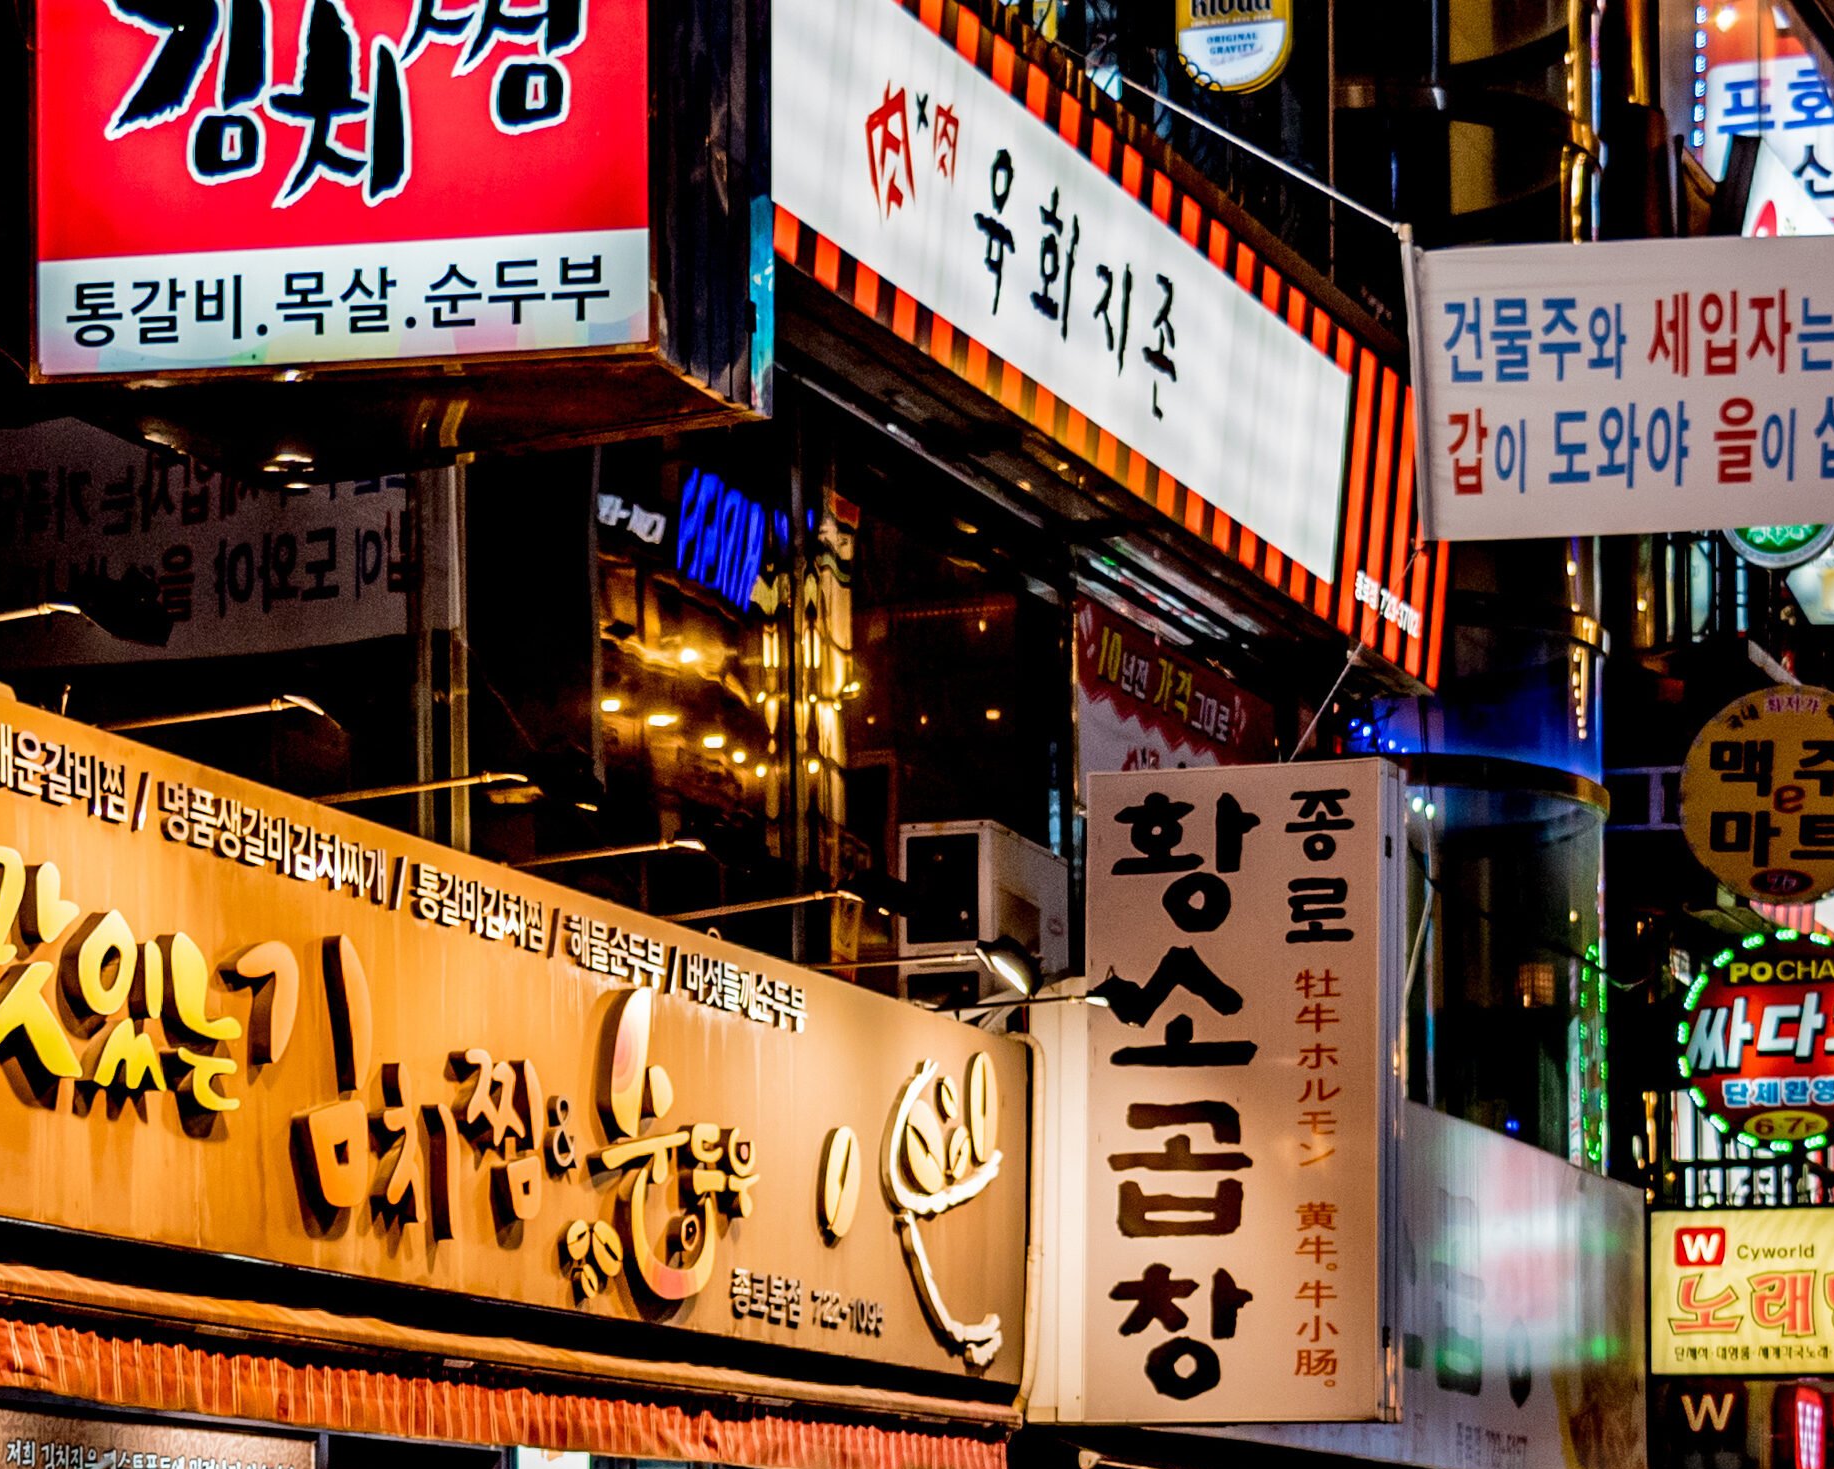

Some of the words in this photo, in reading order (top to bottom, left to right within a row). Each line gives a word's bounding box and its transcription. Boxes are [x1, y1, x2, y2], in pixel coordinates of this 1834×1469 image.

[1207, 32, 1258, 44] ORIGINAL
[1210, 43, 1256, 55] GRAVITY
[974, 148, 1177, 421] 육회지존
[1443, 296, 1627, 384] 건물주와
[1447, 408, 1527, 497] 갑이
[1549, 400, 1688, 488] 도와야
[1714, 396, 1798, 484] 을이
[163, 780, 388, 903] 명품생갈비김치찌개
[417, 864, 544, 952] 통갈비김치찜
[570, 914, 667, 993] 해물순두부
[685, 952, 807, 1033] 버섯들깨순두부
[1285, 788, 1354, 944] 종로
[237, 934, 543, 1240] 김치찜
[601, 987, 759, 1299] 순두부
[1110, 791, 1261, 1401] 황소곱창
[1295, 969, 1342, 1167] 牡牛ホルモン
[1681, 1233, 1720, 1263] W
[1736, 1244, 1815, 1261] Cyworld
[6, 1439, 36, 1467] 저희
[1681, 1393, 1734, 1432] W
